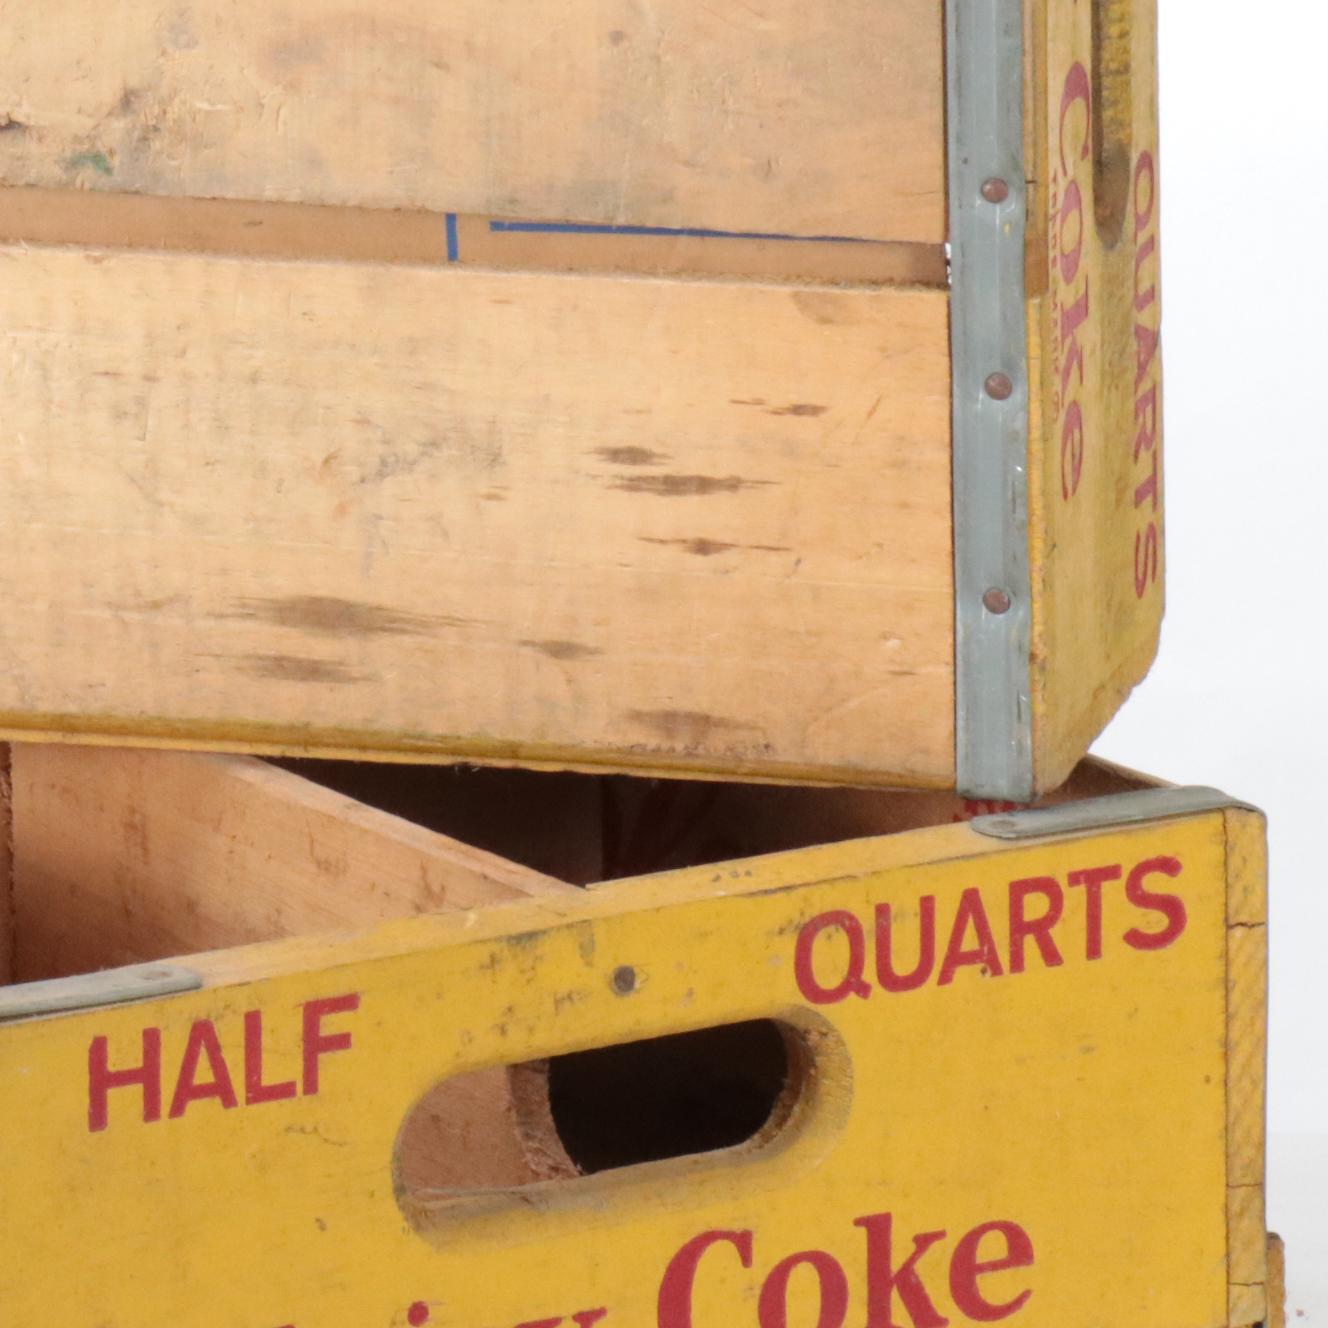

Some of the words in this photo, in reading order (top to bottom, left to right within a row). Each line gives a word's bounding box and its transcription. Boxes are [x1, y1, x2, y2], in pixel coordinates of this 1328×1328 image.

[1059, 61, 1090, 501] Coke
[1133, 149, 1158, 600] QUARTS
[86, 994, 361, 1131] HALF
[794, 855, 1188, 1005] QUARTS
[657, 1212, 1035, 1328] Coke
